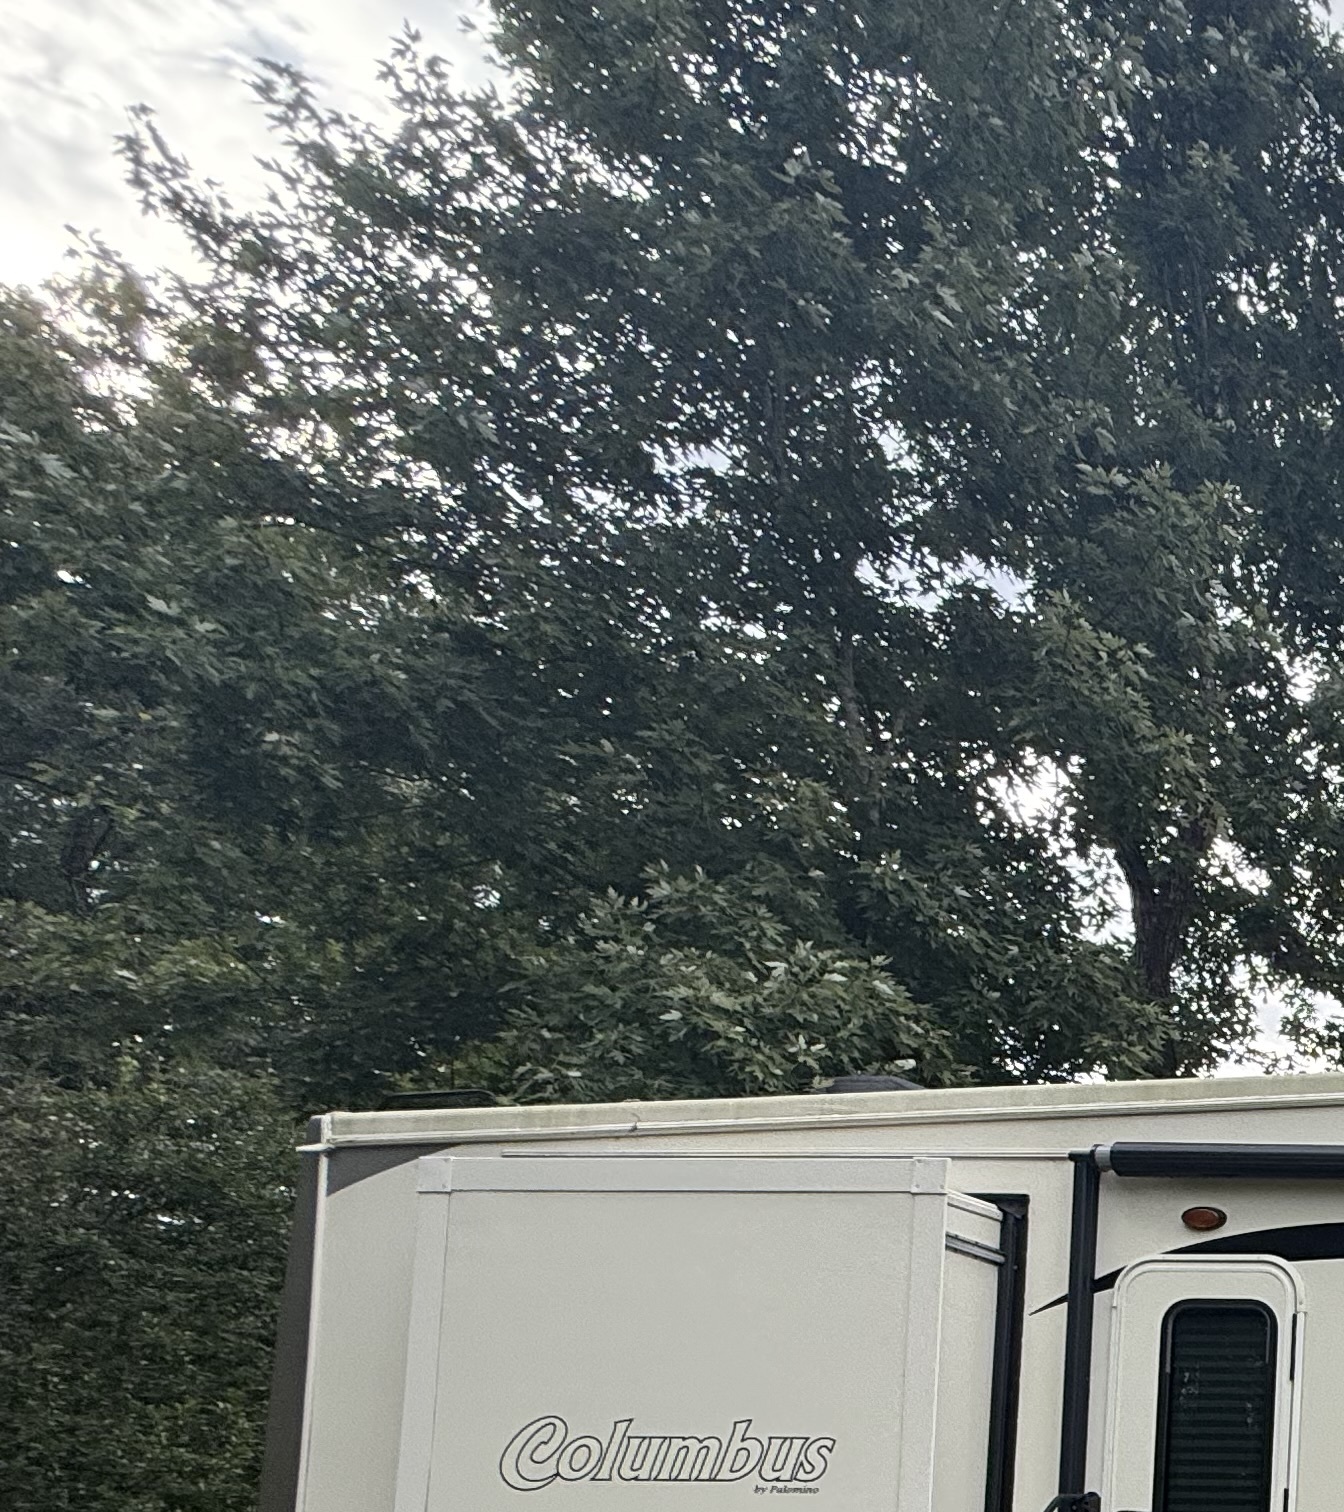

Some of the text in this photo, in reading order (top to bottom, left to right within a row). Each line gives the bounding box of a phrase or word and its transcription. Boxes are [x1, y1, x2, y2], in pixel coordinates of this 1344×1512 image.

[499, 1415, 837, 1492] Columbus
[753, 1484, 820, 1495] by Palomino
